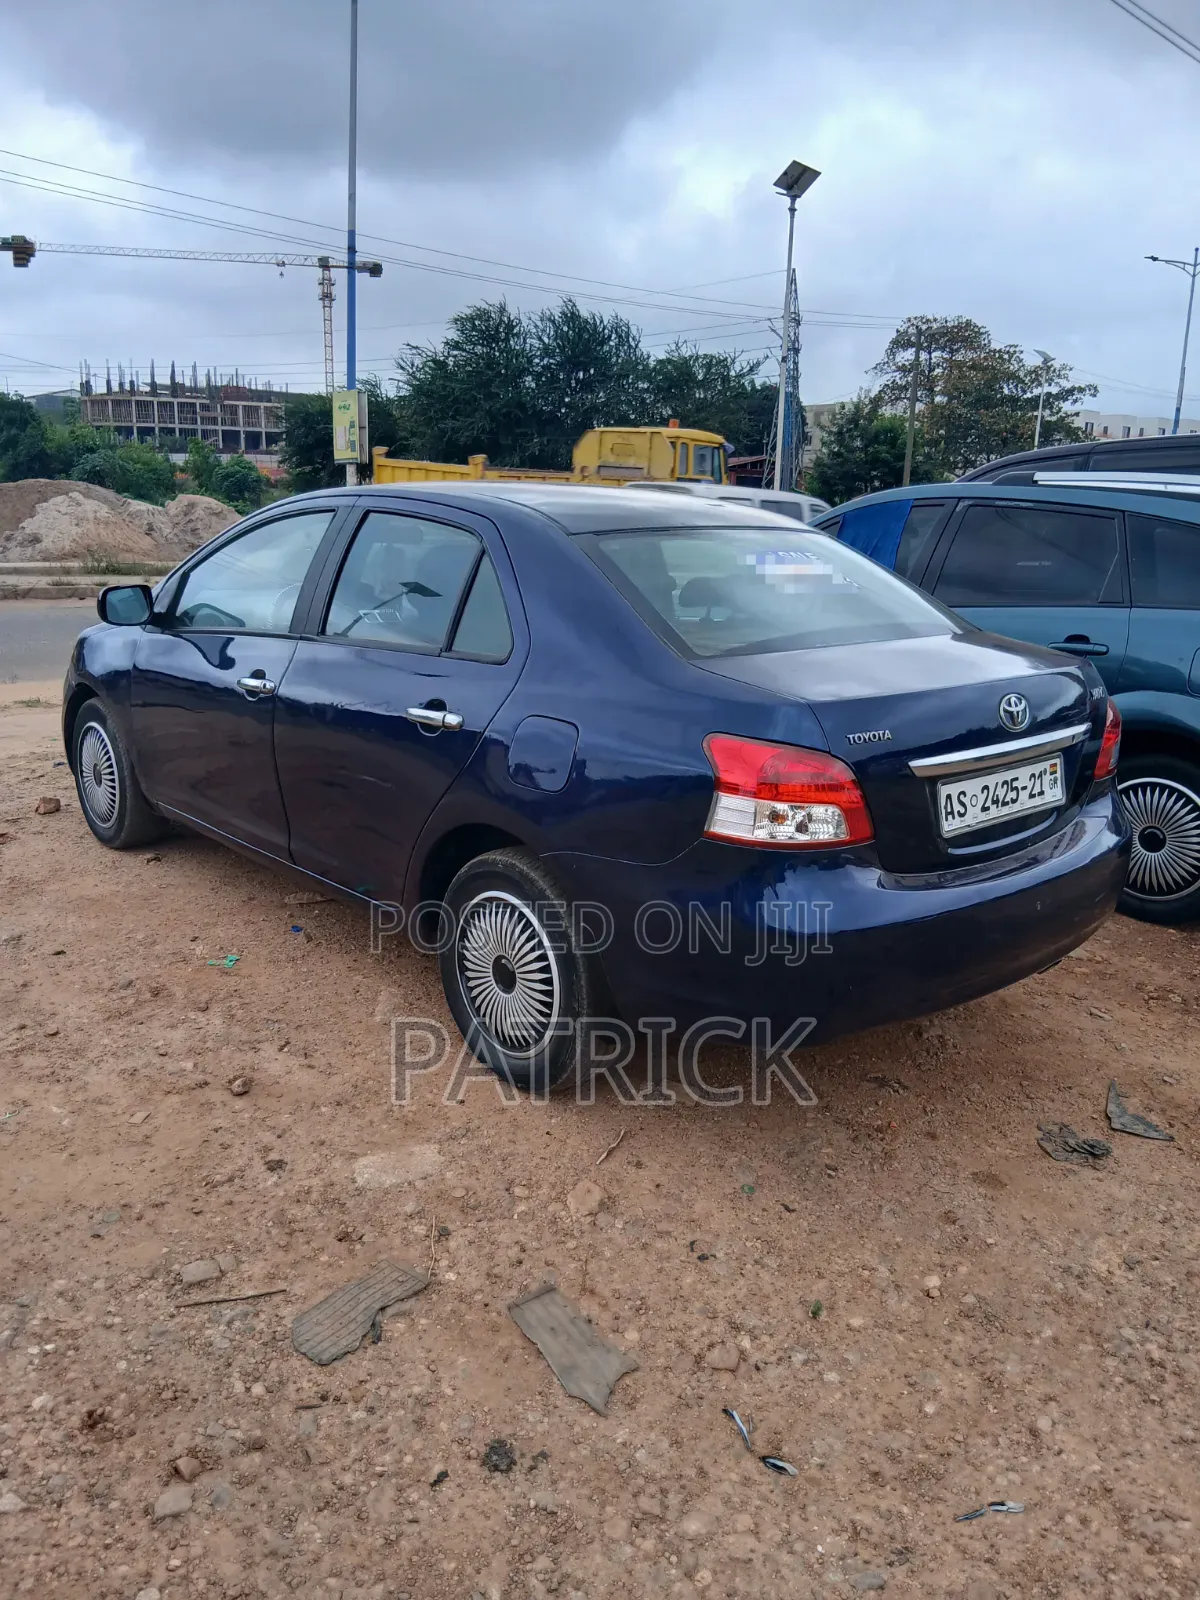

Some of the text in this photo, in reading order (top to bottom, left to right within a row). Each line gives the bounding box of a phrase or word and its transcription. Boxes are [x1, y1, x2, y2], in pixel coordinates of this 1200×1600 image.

[846, 729, 892, 745] TOYOTA
[943, 770, 1045, 822] AS 2425-21
